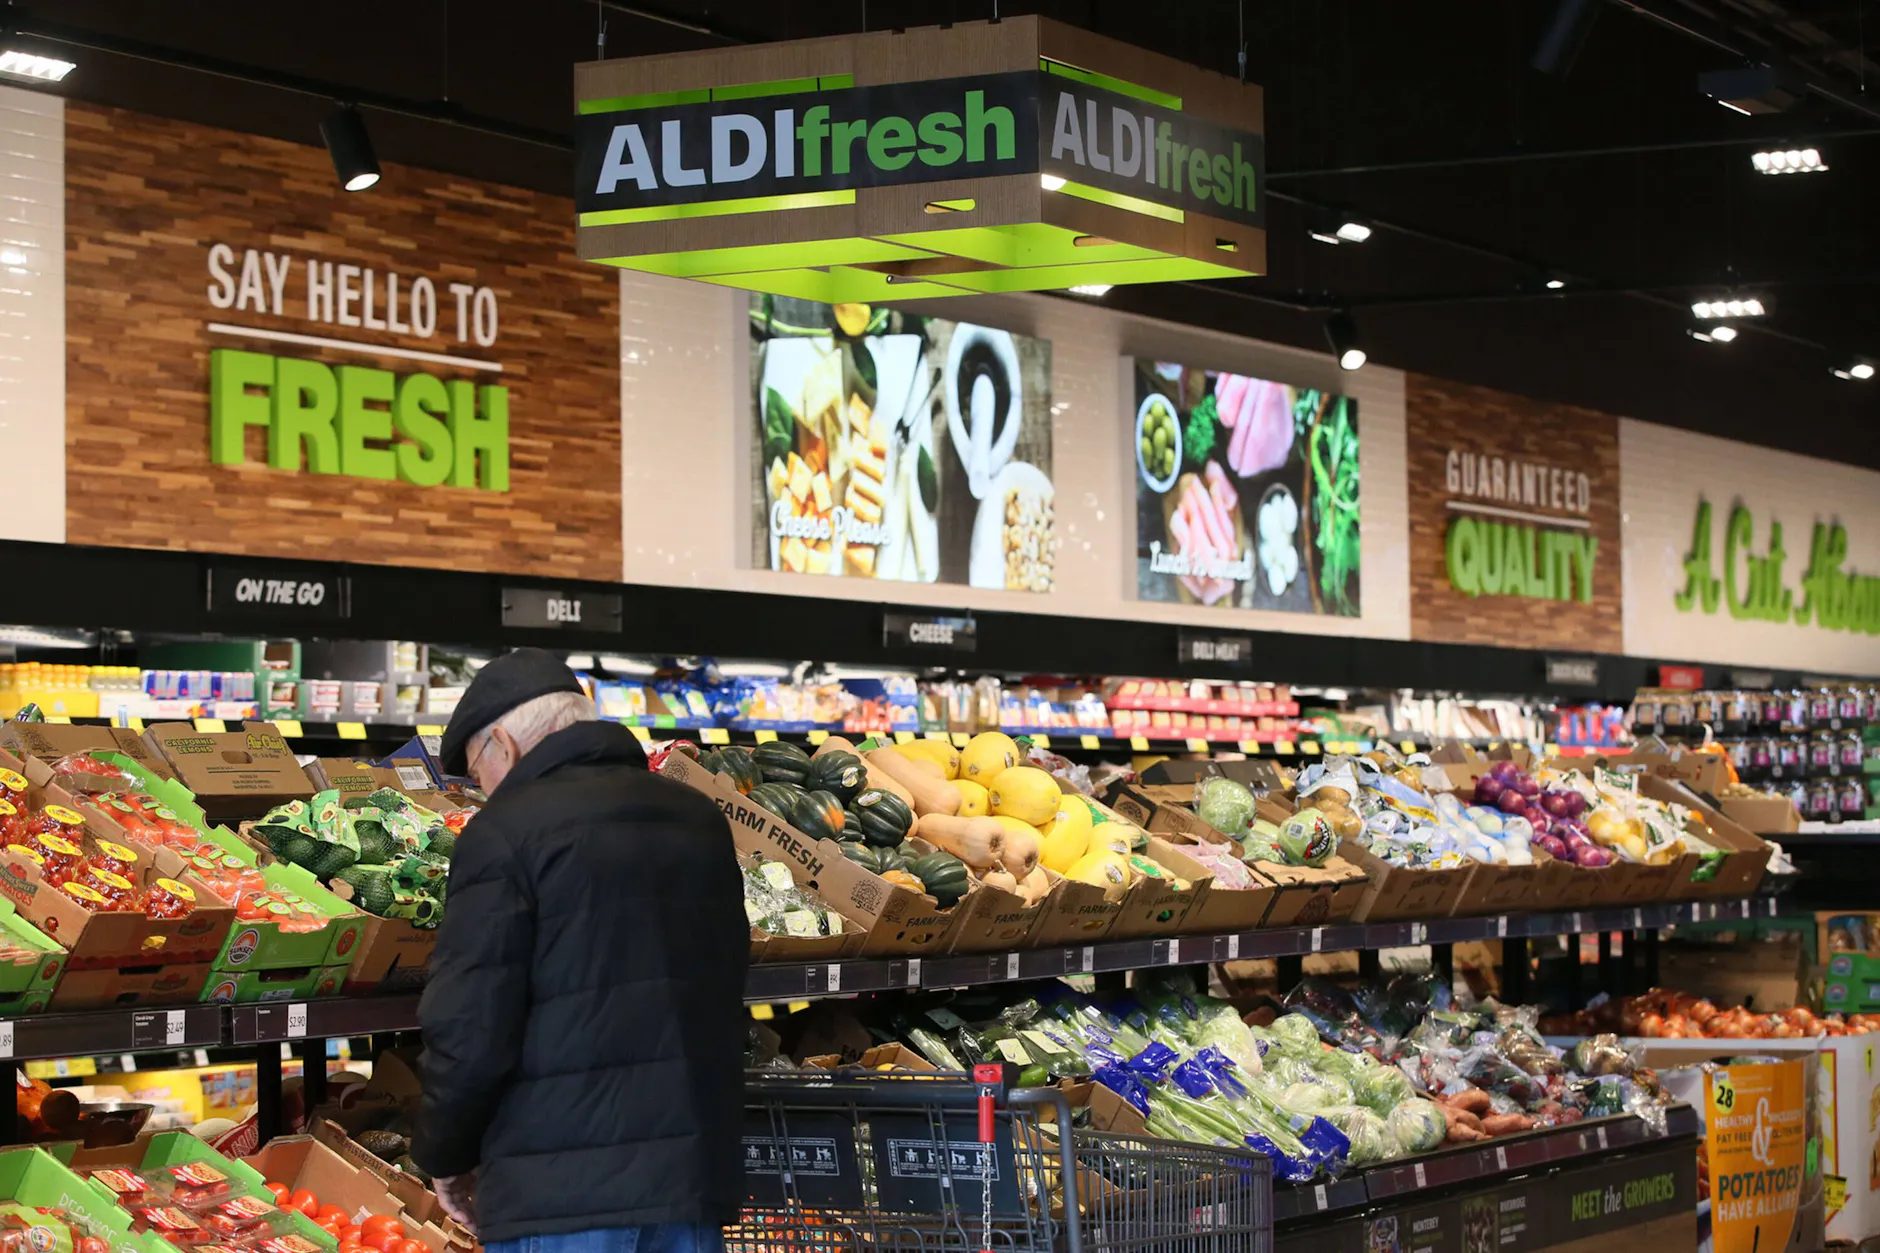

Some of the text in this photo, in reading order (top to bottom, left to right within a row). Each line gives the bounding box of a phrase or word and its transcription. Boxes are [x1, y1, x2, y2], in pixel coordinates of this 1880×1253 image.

[207, 244, 499, 348] SAY HELLO TO
[210, 349, 510, 493] FRESH
[1445, 449, 1592, 514] GUARANTEED
[769, 499, 832, 541] Cheese
[1445, 516, 1598, 604] QUALITY
[1674, 499, 1721, 615] A
[234, 578, 325, 606] ON THE GO
[546, 598, 582, 623] DELI
[909, 621, 954, 645] CHEESE
[164, 737, 217, 748] CALIFORNIA
[176, 746, 213, 755] LEMONS
[331, 776, 375, 785] CALIFORNIA
[341, 784, 373, 792] LEMONS
[714, 797, 825, 877] FARM FRESH
[994, 913, 1024, 924] FARM
[1077, 904, 1107, 915] FARM
[906, 917, 937, 927] FARM
[166, 1021, 184, 1034] $2.49
[289, 1015, 306, 1028] $2.90
[0, 1033, 12, 1047] .89
[1716, 1085, 1734, 1108] 28
[1714, 1114, 1754, 1130] HEALTHY
[1716, 1132, 1733, 1144] FAT
[890, 1140, 899, 1176] WARNING
[1718, 1167, 1800, 1201] POTATOES
[1571, 1172, 1676, 1223] MEET the GROWERS
[1718, 1193, 1798, 1222] HAVE ALLURE
